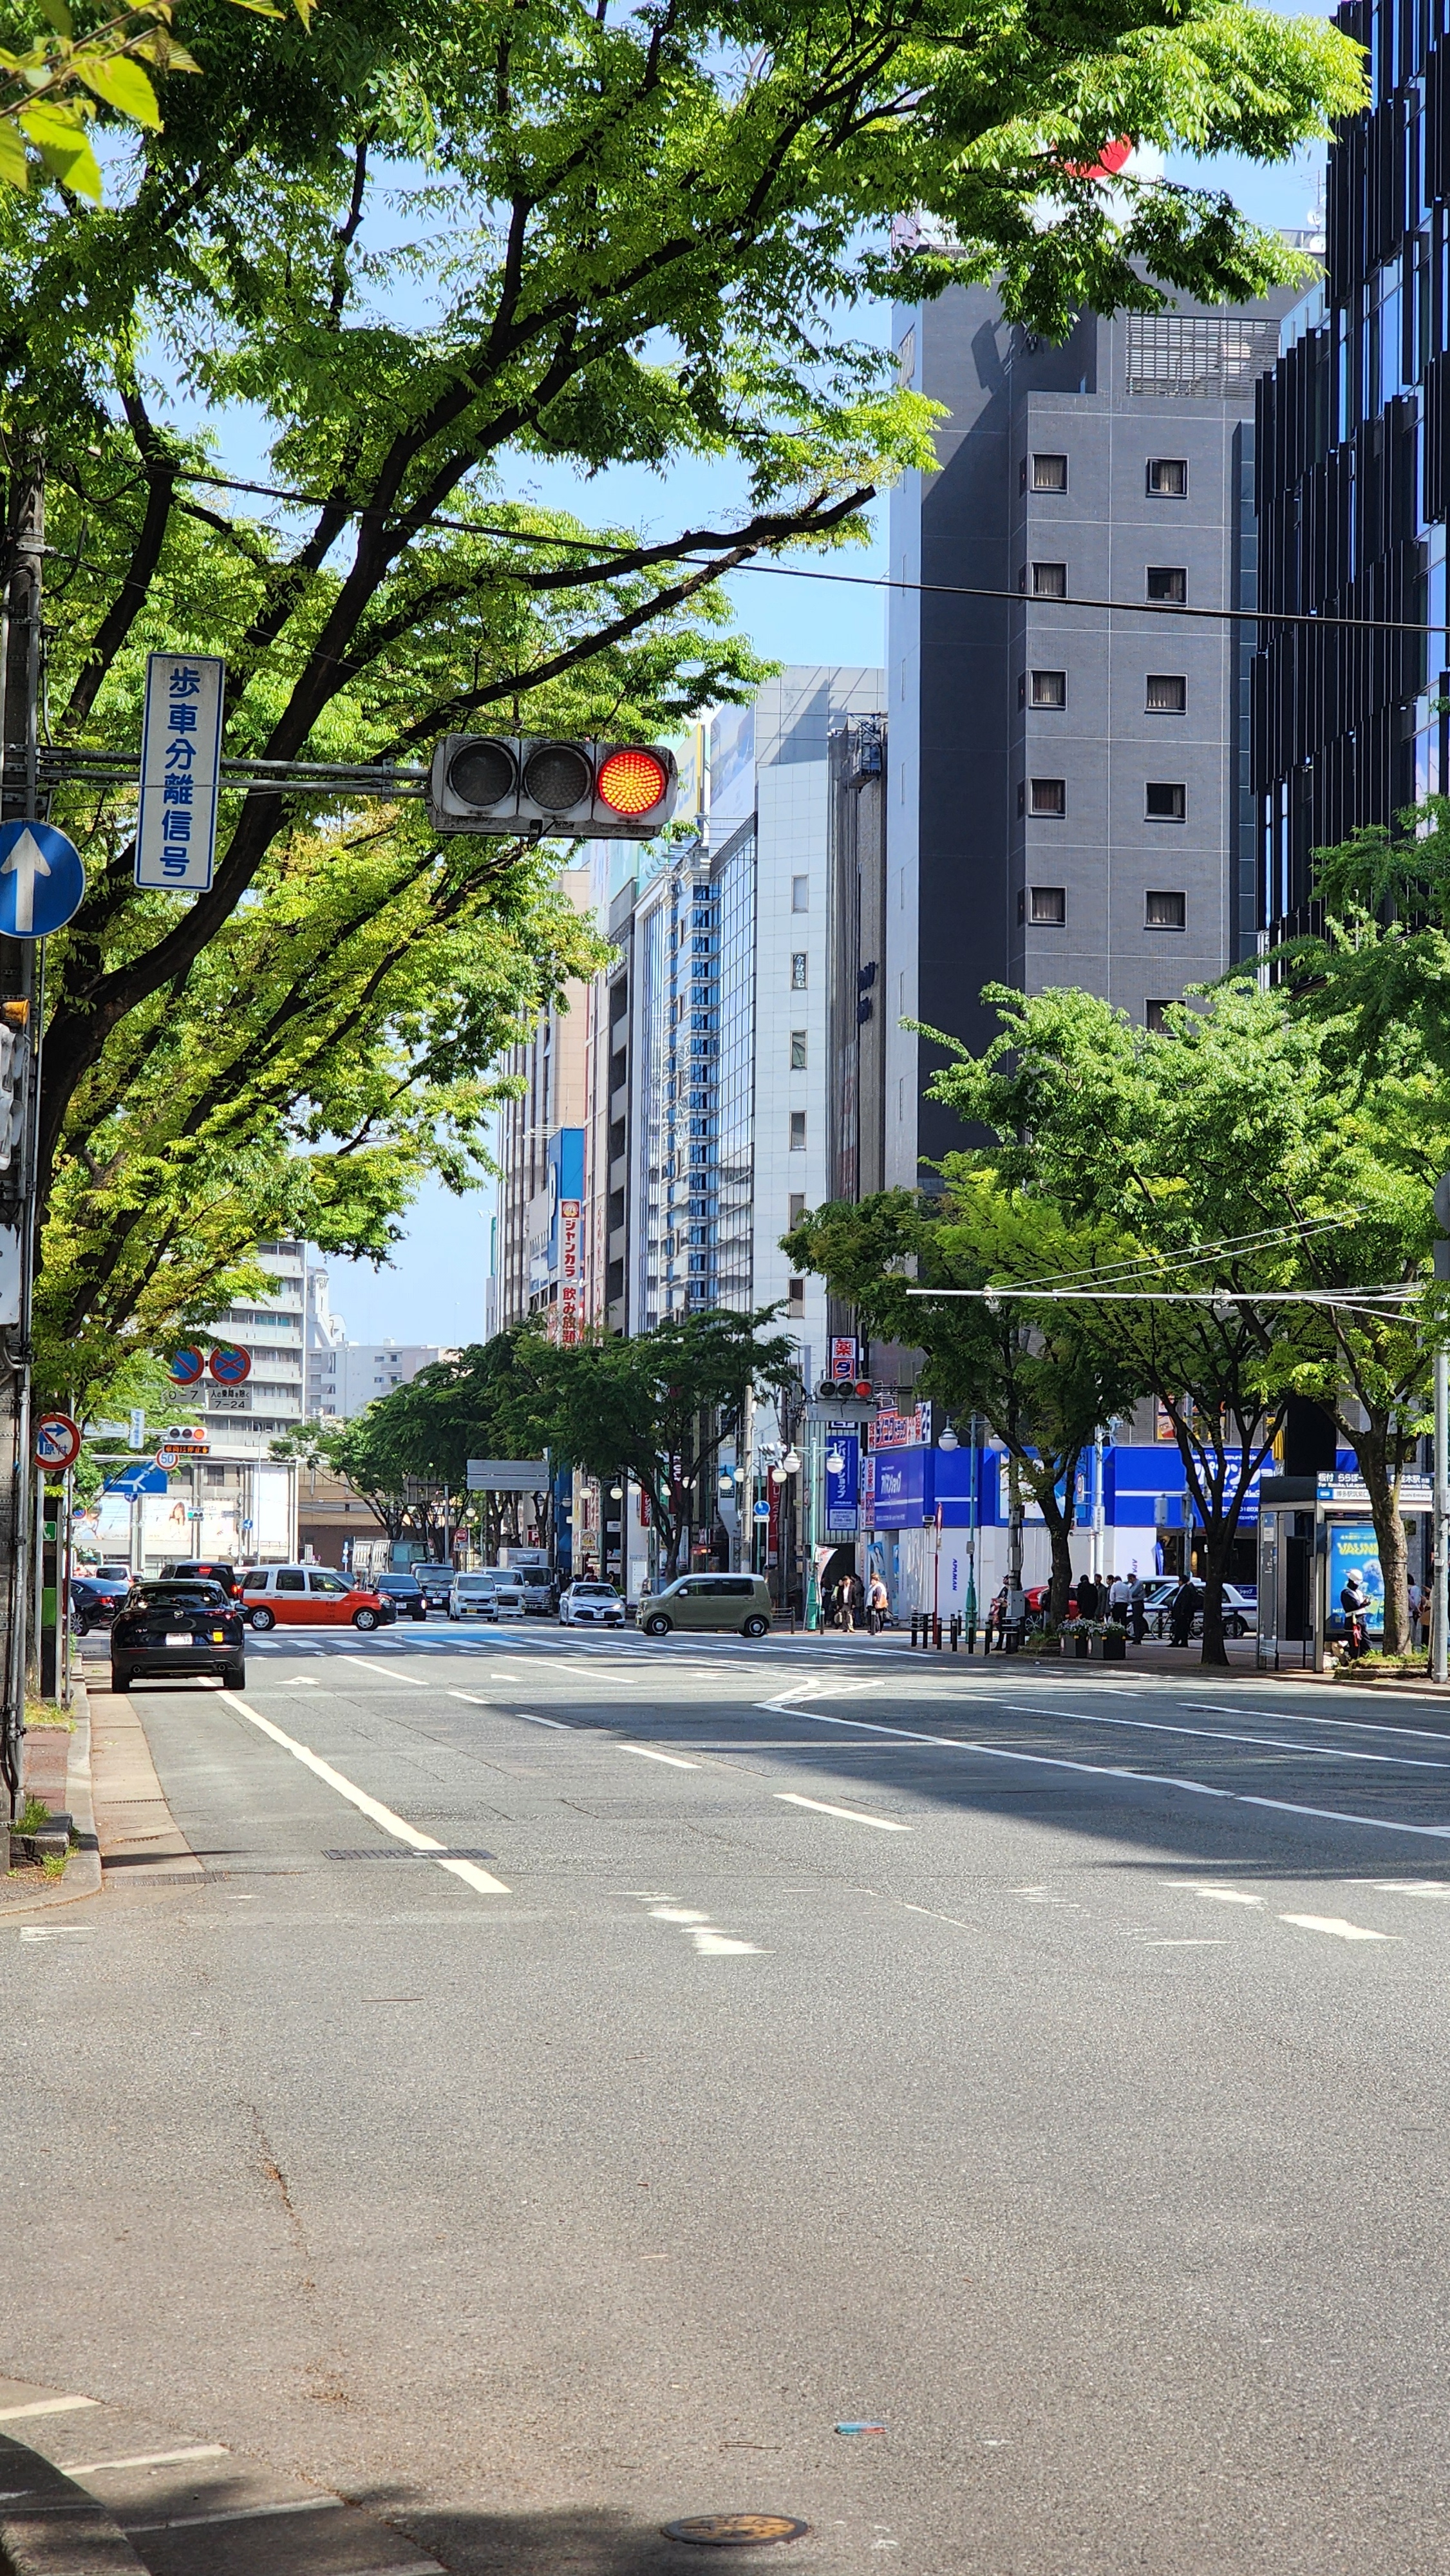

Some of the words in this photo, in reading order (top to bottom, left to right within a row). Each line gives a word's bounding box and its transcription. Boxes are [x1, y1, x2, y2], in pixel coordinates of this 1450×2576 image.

[160, 667, 200, 877] 歩車分離信号
[565, 1219, 576, 1277] ジャンカラ
[215, 1401, 245, 1409] 7-24
[44, 1443, 68, 1455] 原付
[161, 1454, 174, 1464] 50
[838, 1441, 846, 1499] アパショップ
